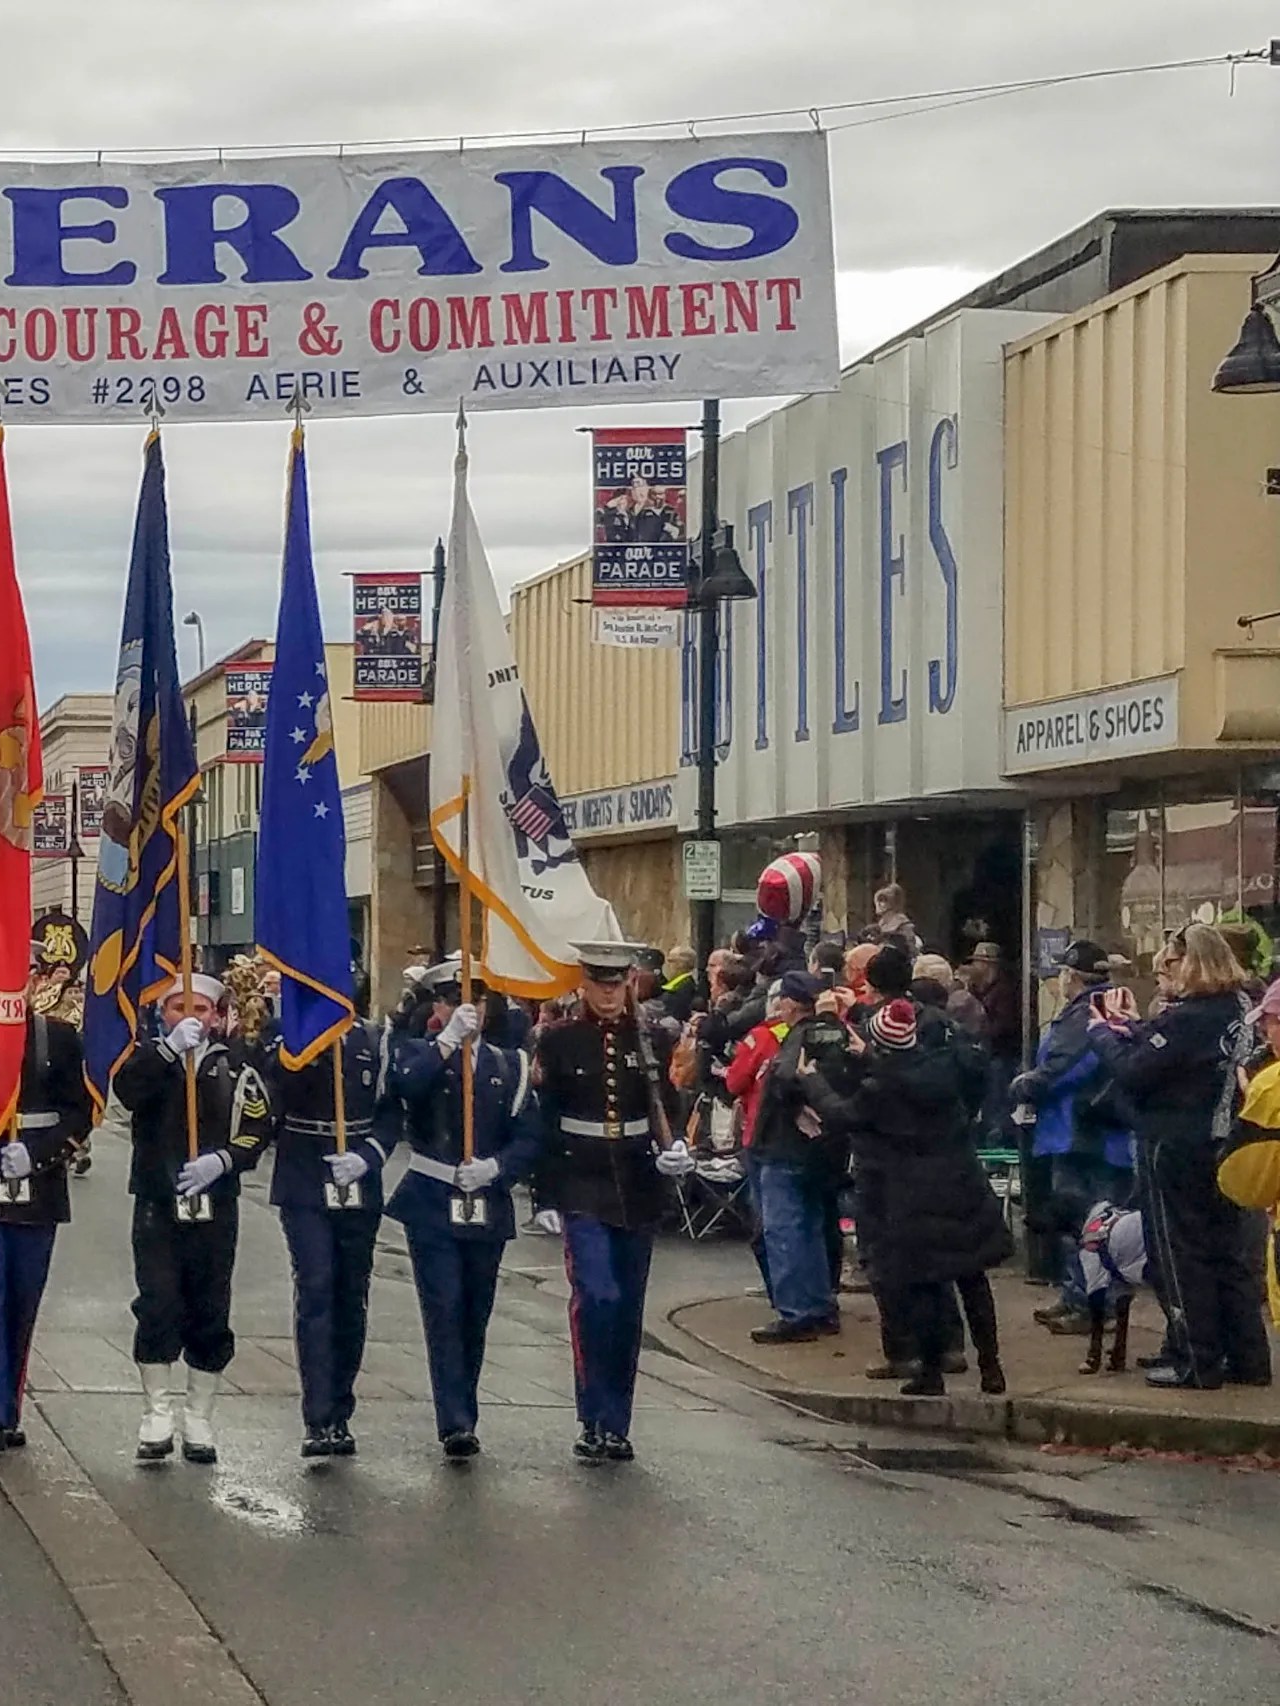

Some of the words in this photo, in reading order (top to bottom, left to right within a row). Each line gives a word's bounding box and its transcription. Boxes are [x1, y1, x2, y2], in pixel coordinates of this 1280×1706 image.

[299, 303, 342, 356] &
[370, 278, 801, 353] COMMITMENT
[92, 376, 206, 405] #2298
[246, 371, 361, 401] AERIE
[402, 368, 425, 395] &
[472, 353, 682, 392] AUXILIARY
[597, 461, 683, 479] HEROES
[599, 562, 681, 579] PARADE
[355, 596, 419, 610] HEROES
[357, 669, 419, 682] PARADE
[1015, 712, 1085, 755] APPAREL
[1088, 708, 1101, 742] &
[1104, 696, 1165, 740] SHOES
[583, 795, 612, 828] NIGHTS
[630, 783, 673, 823] SUNDAYS
[685, 844, 695, 858] 2
